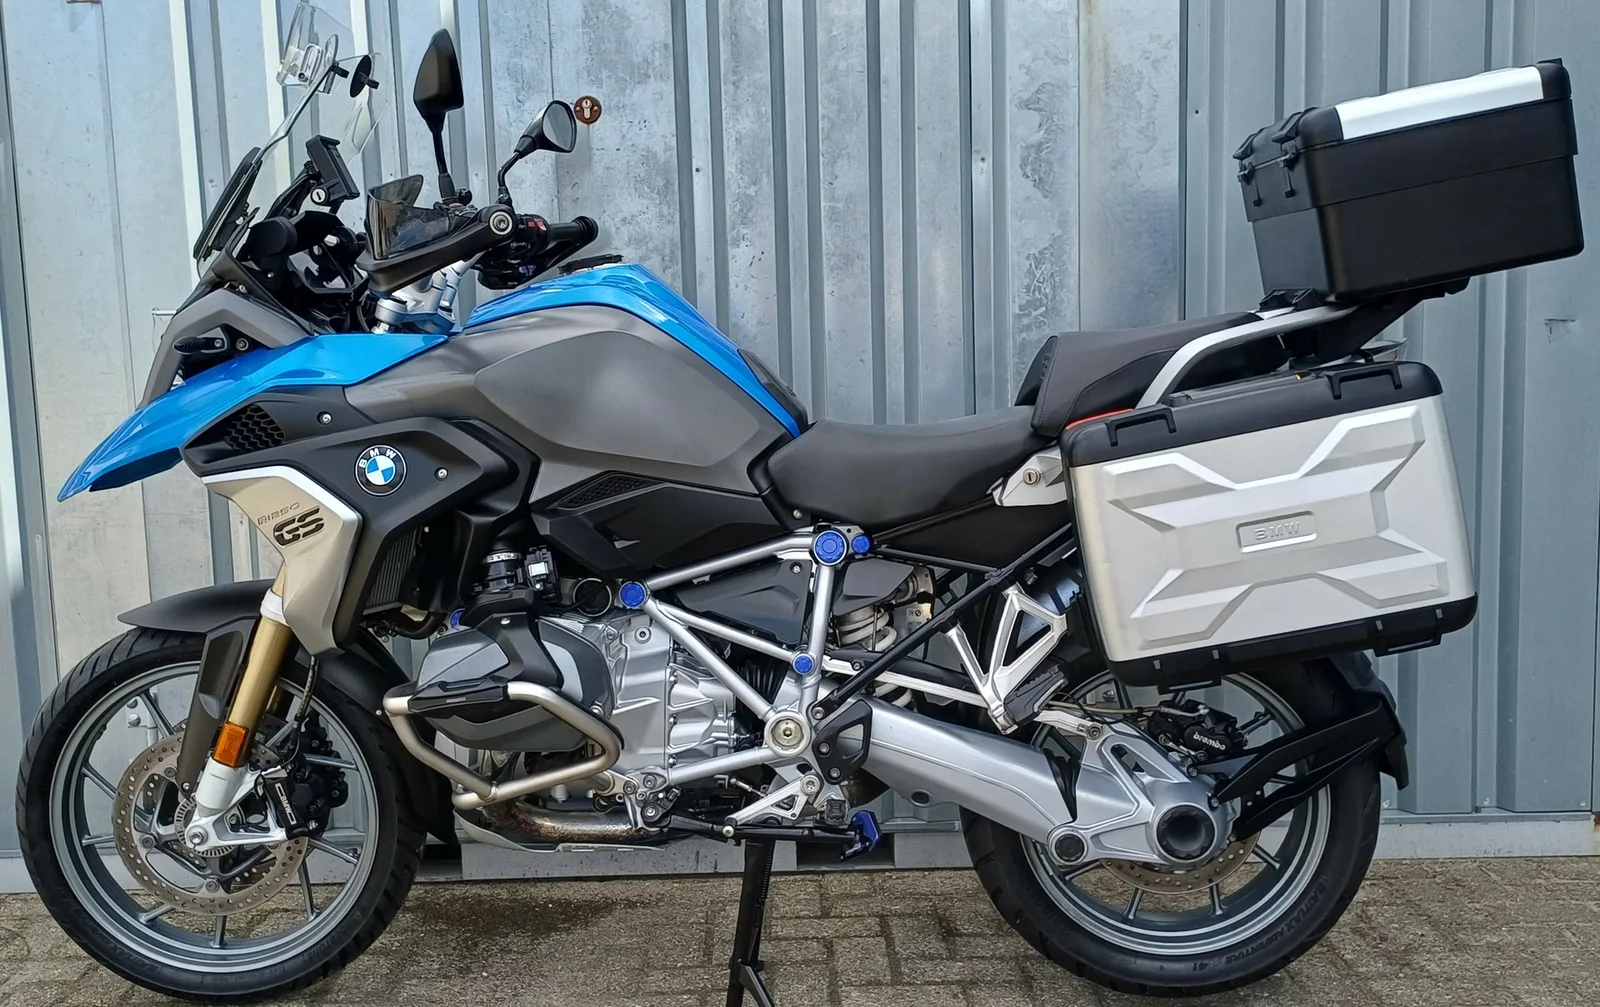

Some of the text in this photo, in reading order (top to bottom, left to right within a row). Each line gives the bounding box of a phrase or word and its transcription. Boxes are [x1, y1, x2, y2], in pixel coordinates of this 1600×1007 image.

[358, 448, 397, 468] BMW
[273, 506, 325, 546] GS
[1254, 521, 1300, 540] BMW
